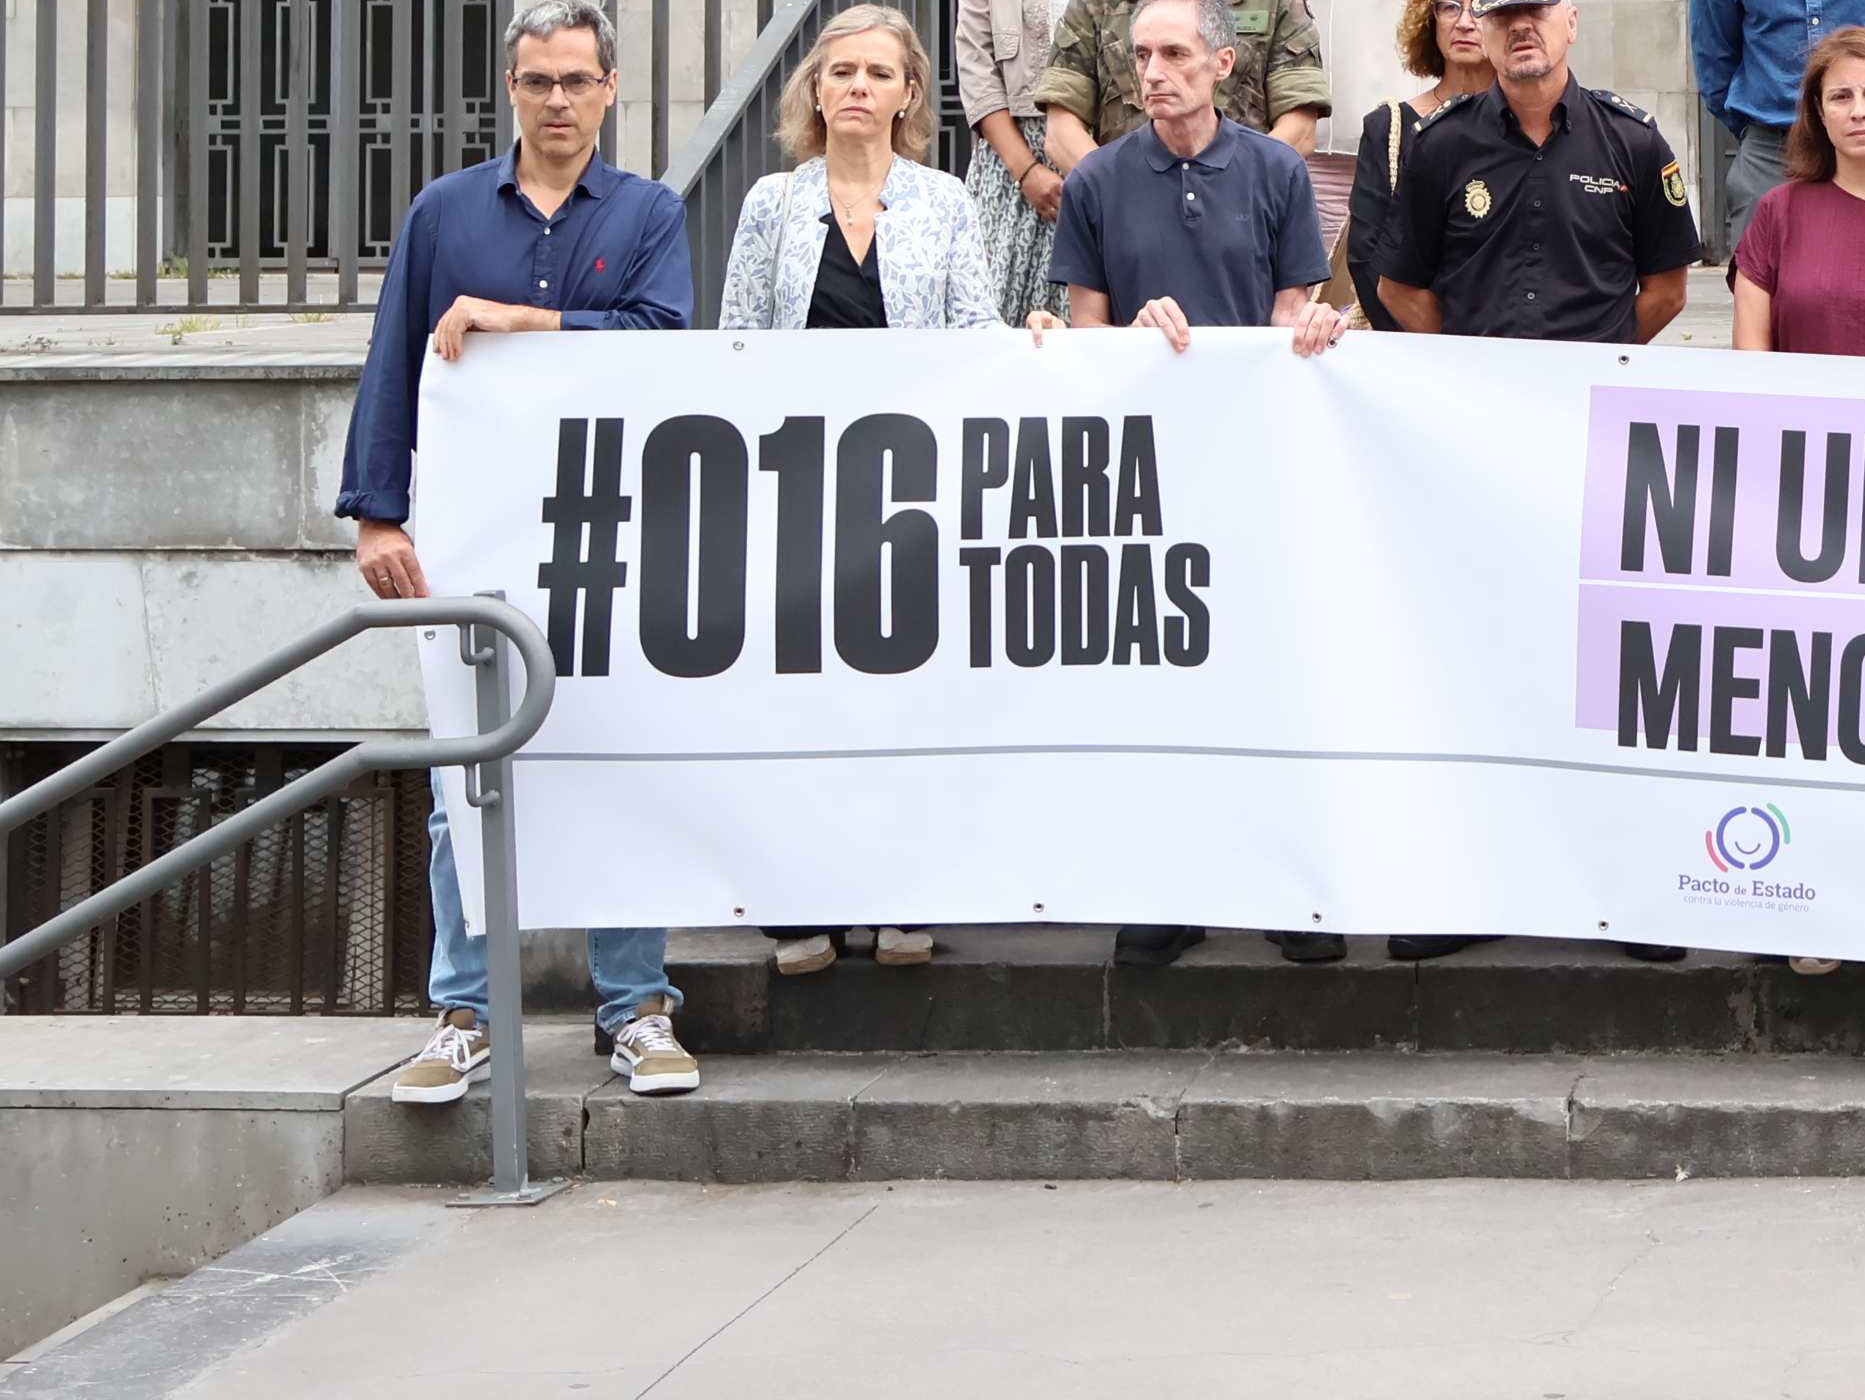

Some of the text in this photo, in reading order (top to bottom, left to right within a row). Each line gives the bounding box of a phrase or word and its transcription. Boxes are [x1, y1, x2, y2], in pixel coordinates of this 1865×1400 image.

[1584, 185, 1614, 195] CNP
[960, 414, 1164, 540] PARA
[1620, 421, 1740, 577] NI
[537, 412, 940, 678] #016
[959, 542, 1211, 668] TODAS
[1678, 874, 1817, 901] Pacto de Estado
